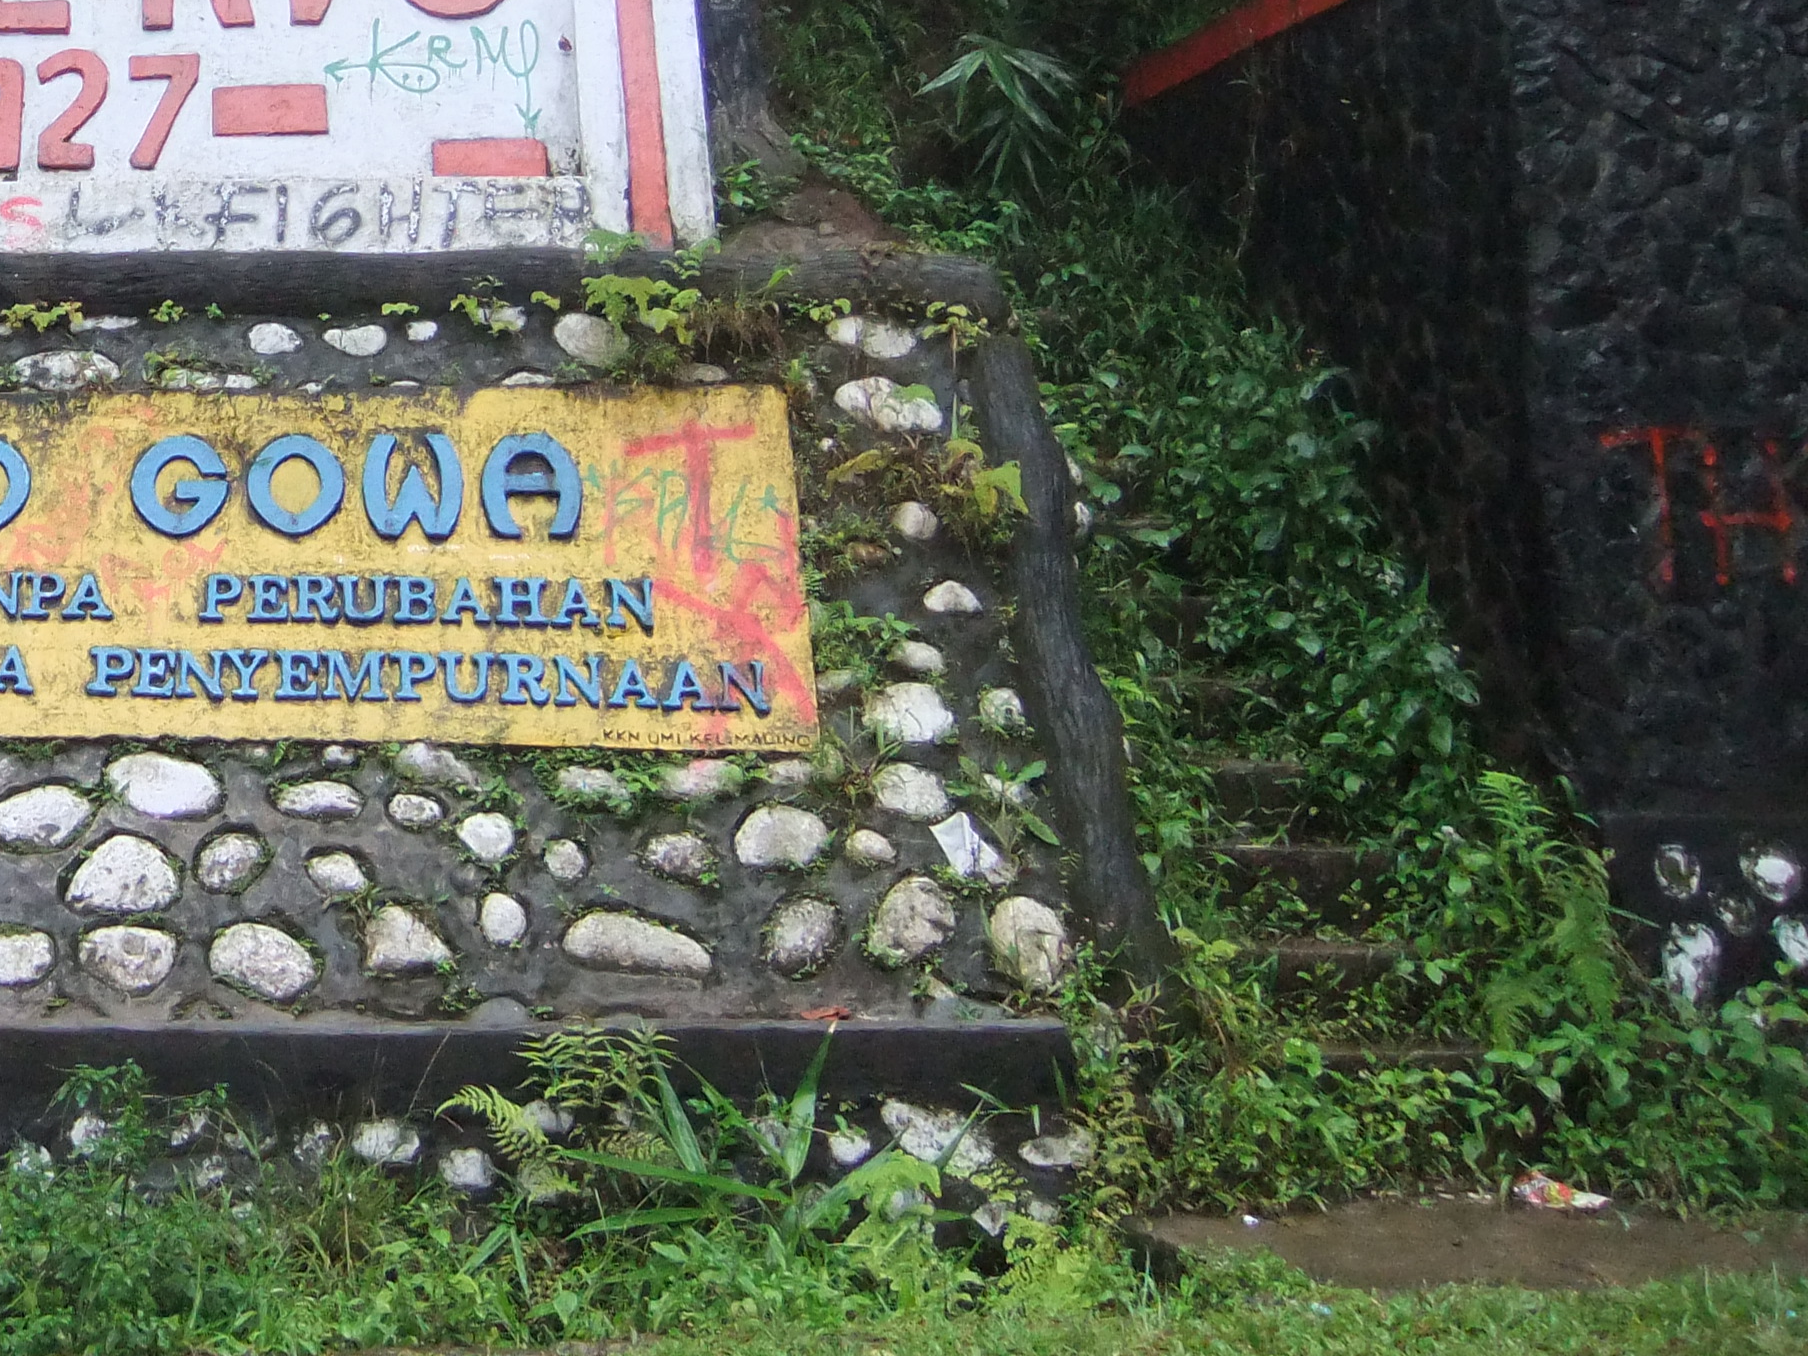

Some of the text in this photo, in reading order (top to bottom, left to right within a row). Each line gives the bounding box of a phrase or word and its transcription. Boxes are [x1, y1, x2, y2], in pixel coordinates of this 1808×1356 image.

[129, 429, 584, 542] GOWA
[197, 573, 655, 638] PERUBAHAN
[85, 646, 772, 719] PENYEMPURNAAN
[602, 728, 640, 743] KKN
[647, 732, 681, 745] UMI
